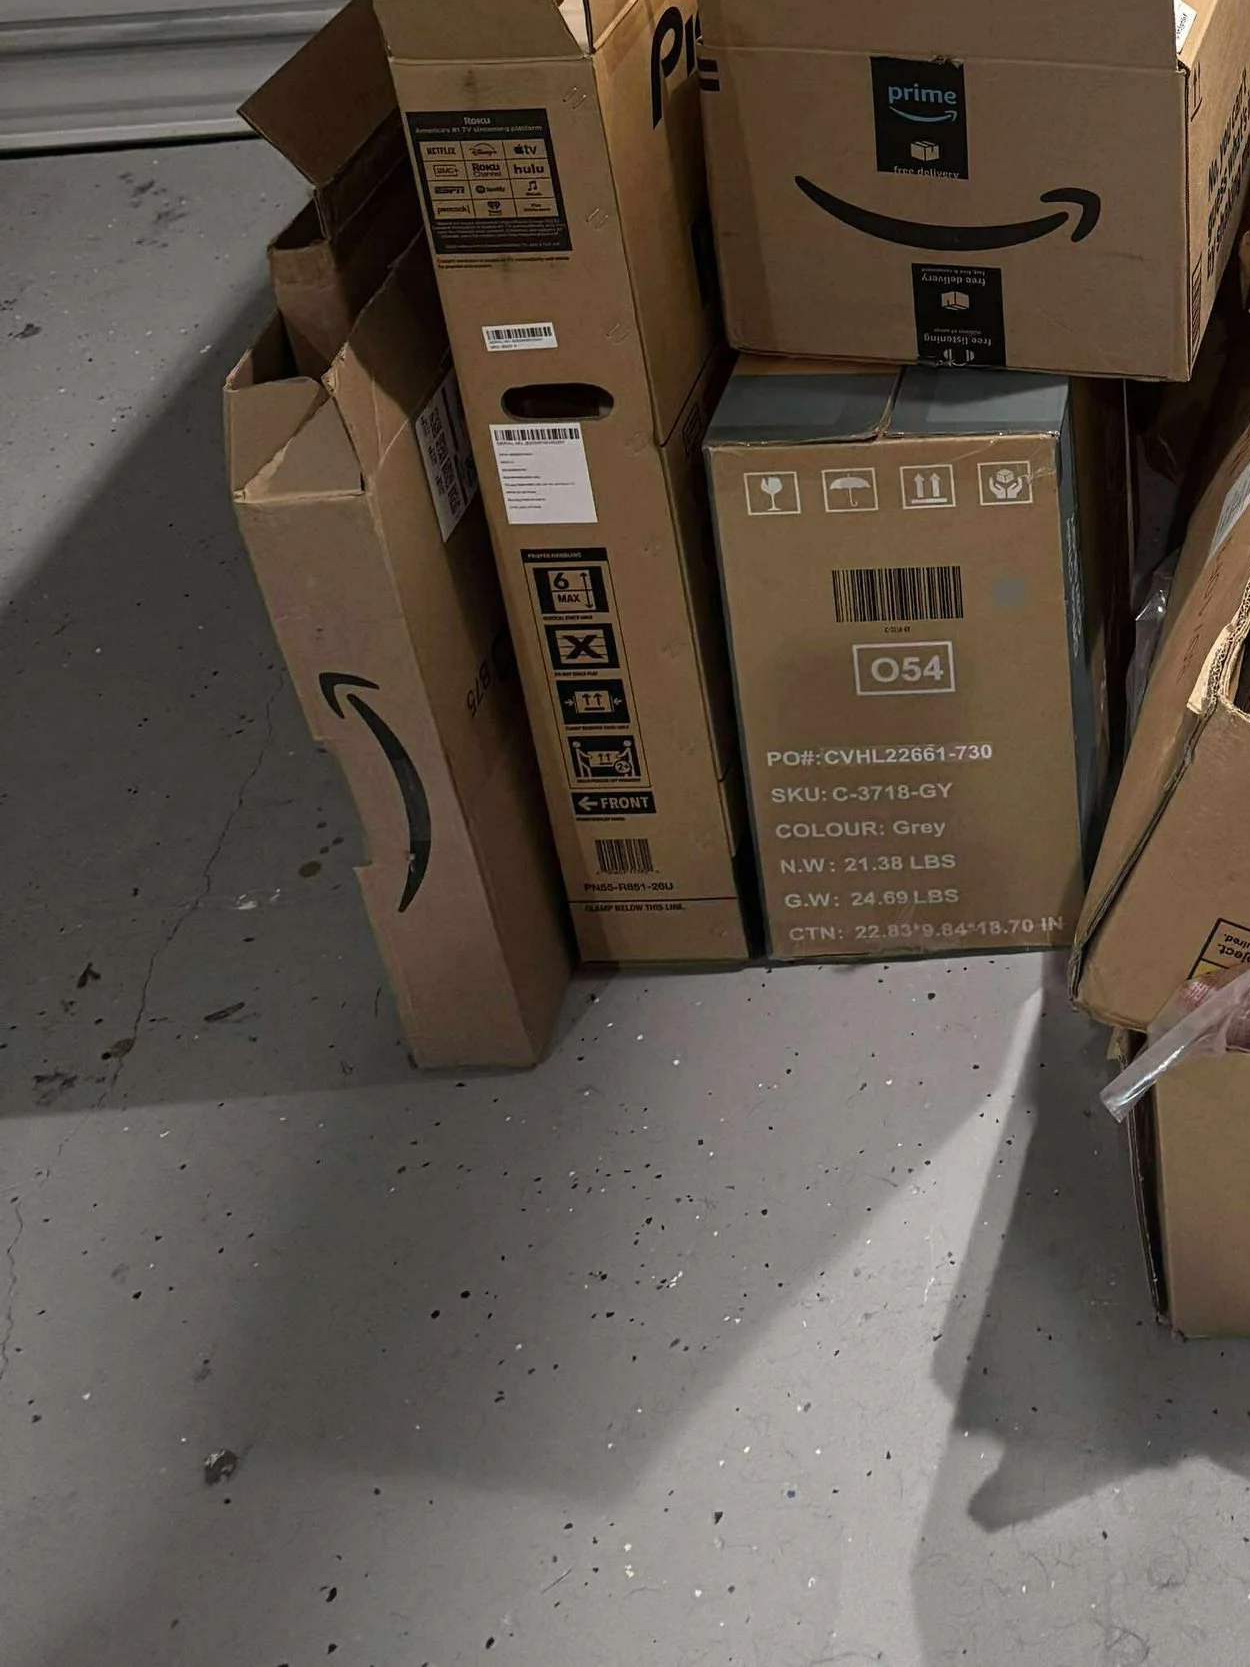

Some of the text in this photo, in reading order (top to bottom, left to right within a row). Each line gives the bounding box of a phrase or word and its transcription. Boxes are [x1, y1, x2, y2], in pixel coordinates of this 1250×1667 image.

[887, 83, 957, 104] prime
[464, 117, 491, 125] Roku
[511, 125, 543, 133] platform
[427, 146, 456, 155] NETFLIX
[524, 145, 537, 155] tv
[472, 163, 500, 171] Roku
[514, 164, 544, 173] hulu
[921, 272, 986, 288] free delivery
[924, 332, 992, 347] free listening
[553, 573, 569, 589] 6
[558, 594, 580, 603] MAX
[771, 782, 953, 804] SKU: C-3718-GY
[600, 796, 649, 809] FRONT
[775, 819, 946, 840] COLOUR: Grey
[844, 855, 904, 873] 21.38
[910, 853, 956, 871] LBS
[850, 889, 910, 908] 24.69
[913, 887, 959, 905] LBS
[789, 925, 843, 943] CTN:
